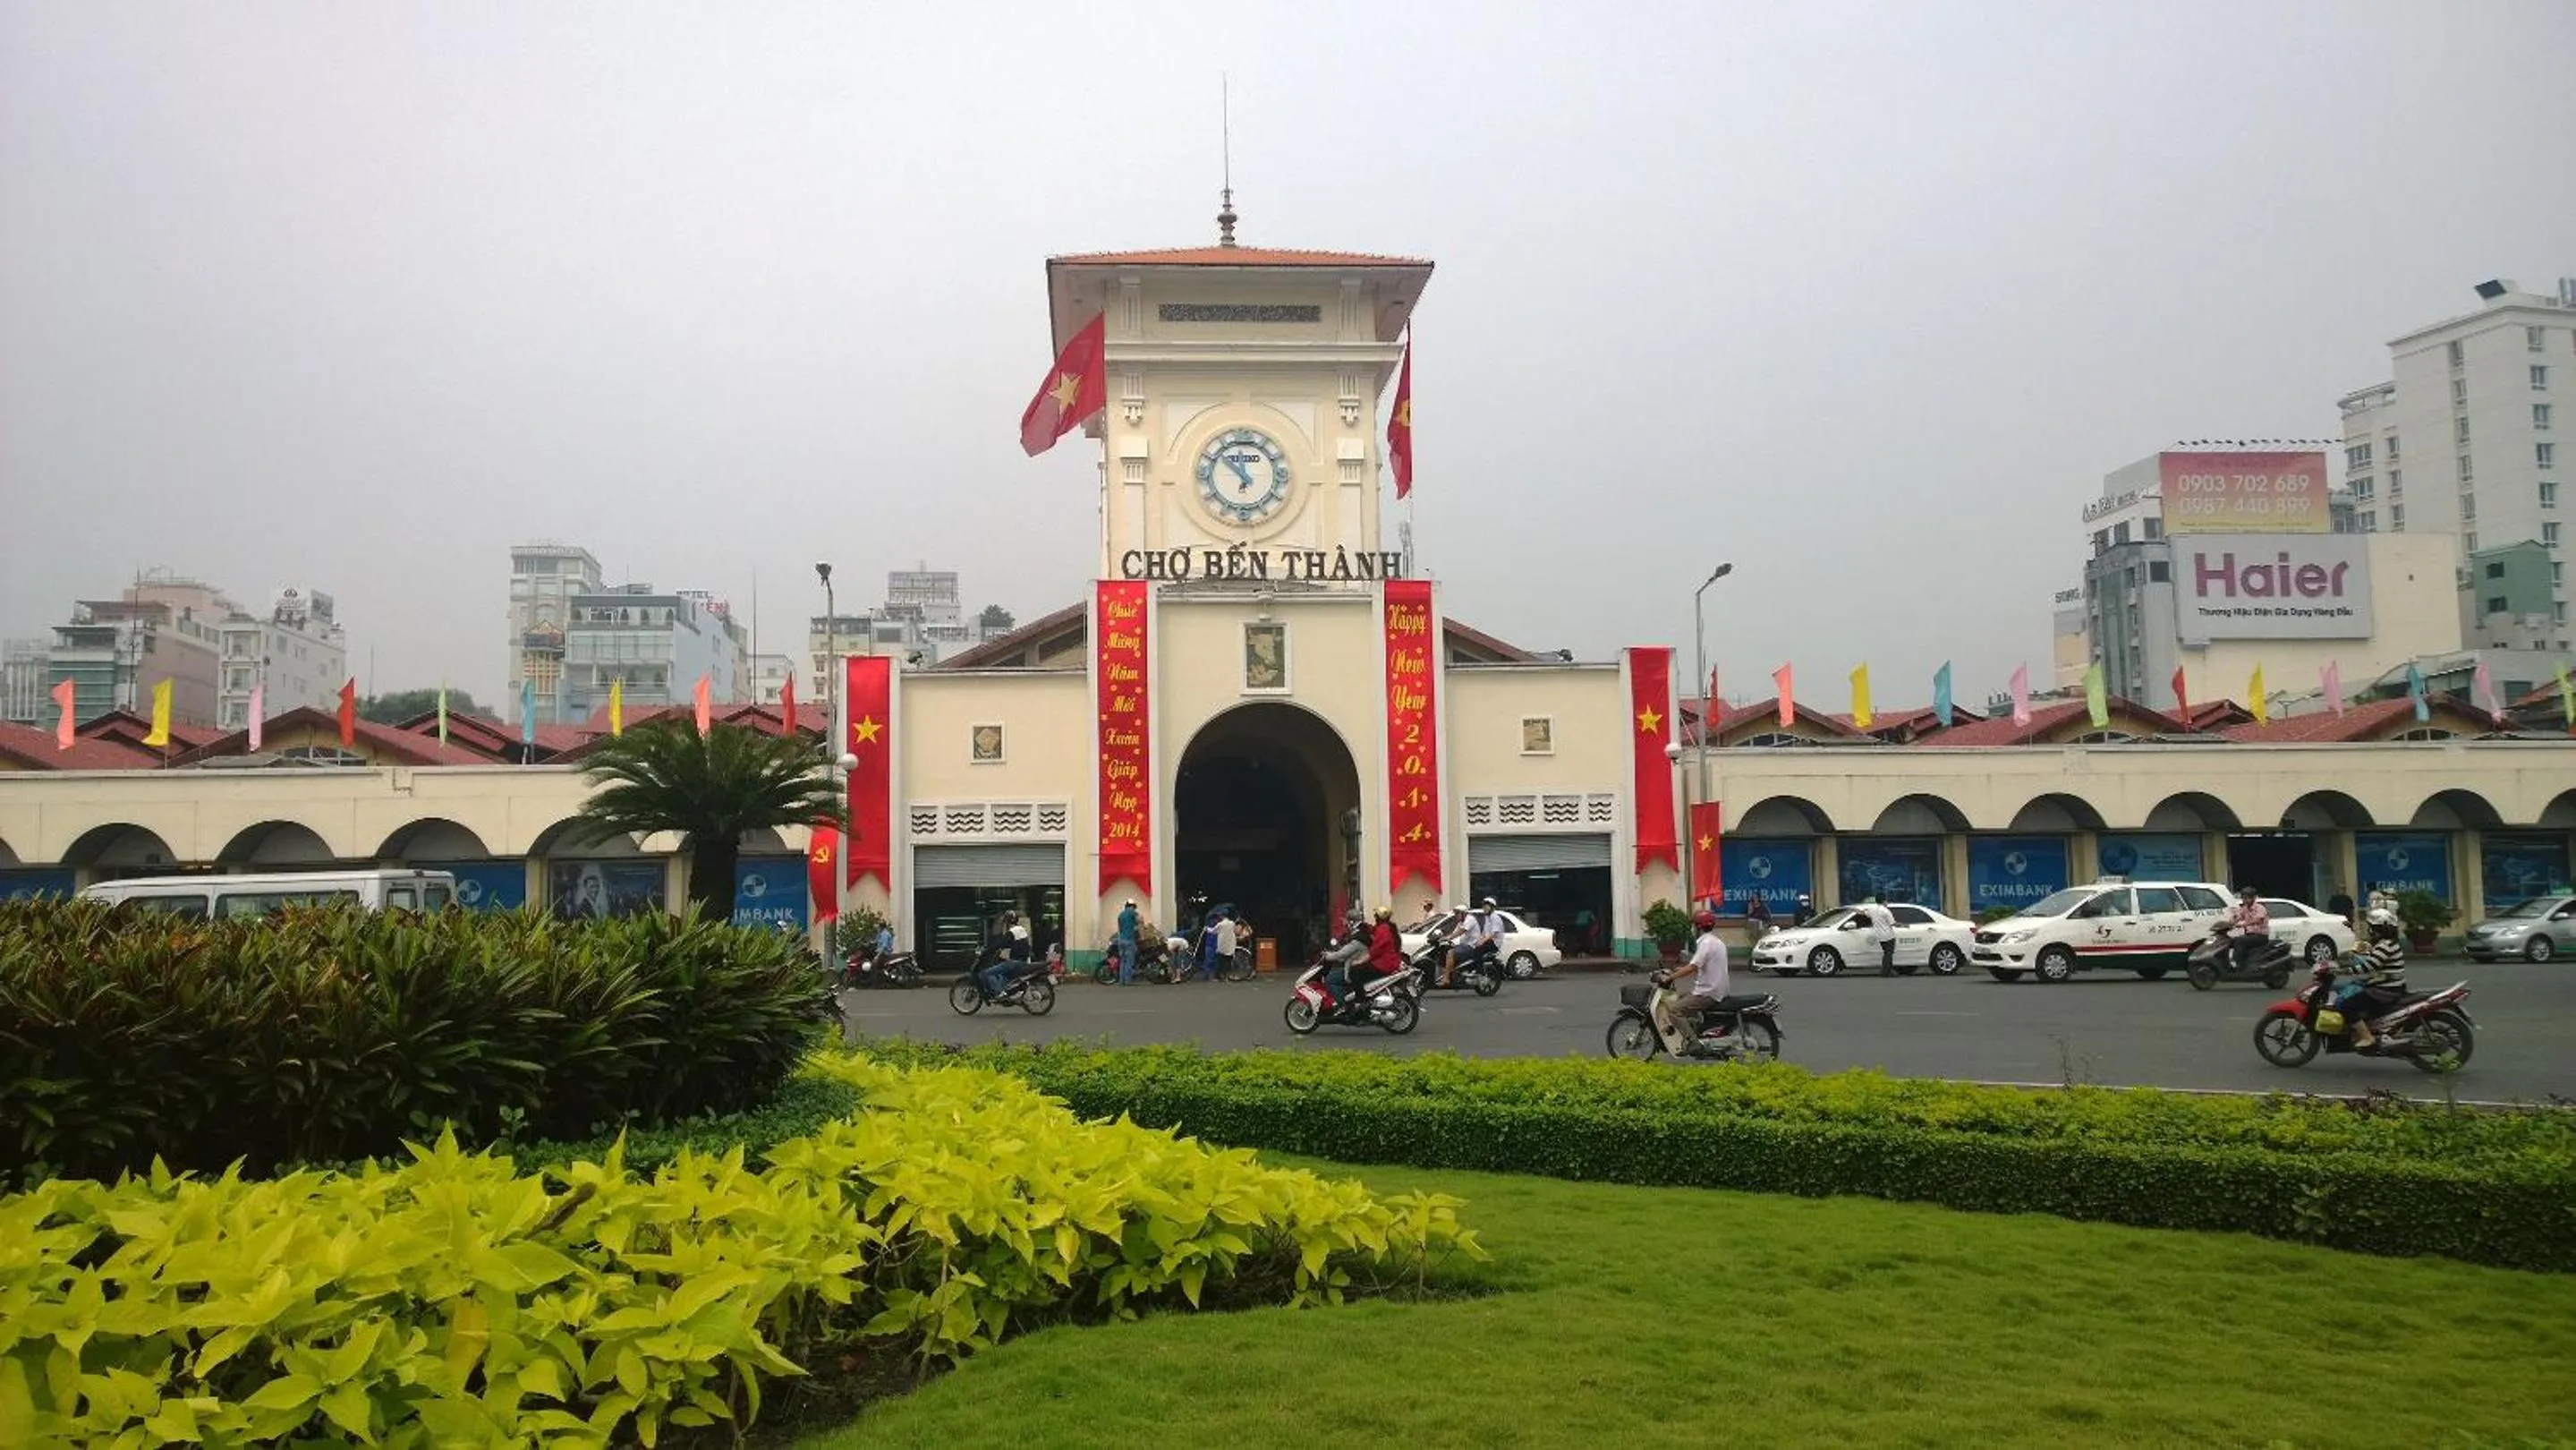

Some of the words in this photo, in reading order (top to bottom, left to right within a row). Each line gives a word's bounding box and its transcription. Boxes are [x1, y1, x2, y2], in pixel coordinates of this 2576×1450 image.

[2179, 474, 2226, 491] 0903
[2231, 474, 2268, 491] 702
[2274, 474, 2310, 491] 689
[1203, 542, 1269, 580] BẾN
[1281, 543, 1401, 580] THÀNH
[2194, 551, 2350, 597] Haier
[1389, 604, 1426, 636] Happy
[1390, 648, 1426, 673] New
[1390, 684, 1427, 715] Year
[1109, 823, 1140, 838] 2014
[1978, 883, 2054, 896] EXIMBANK
